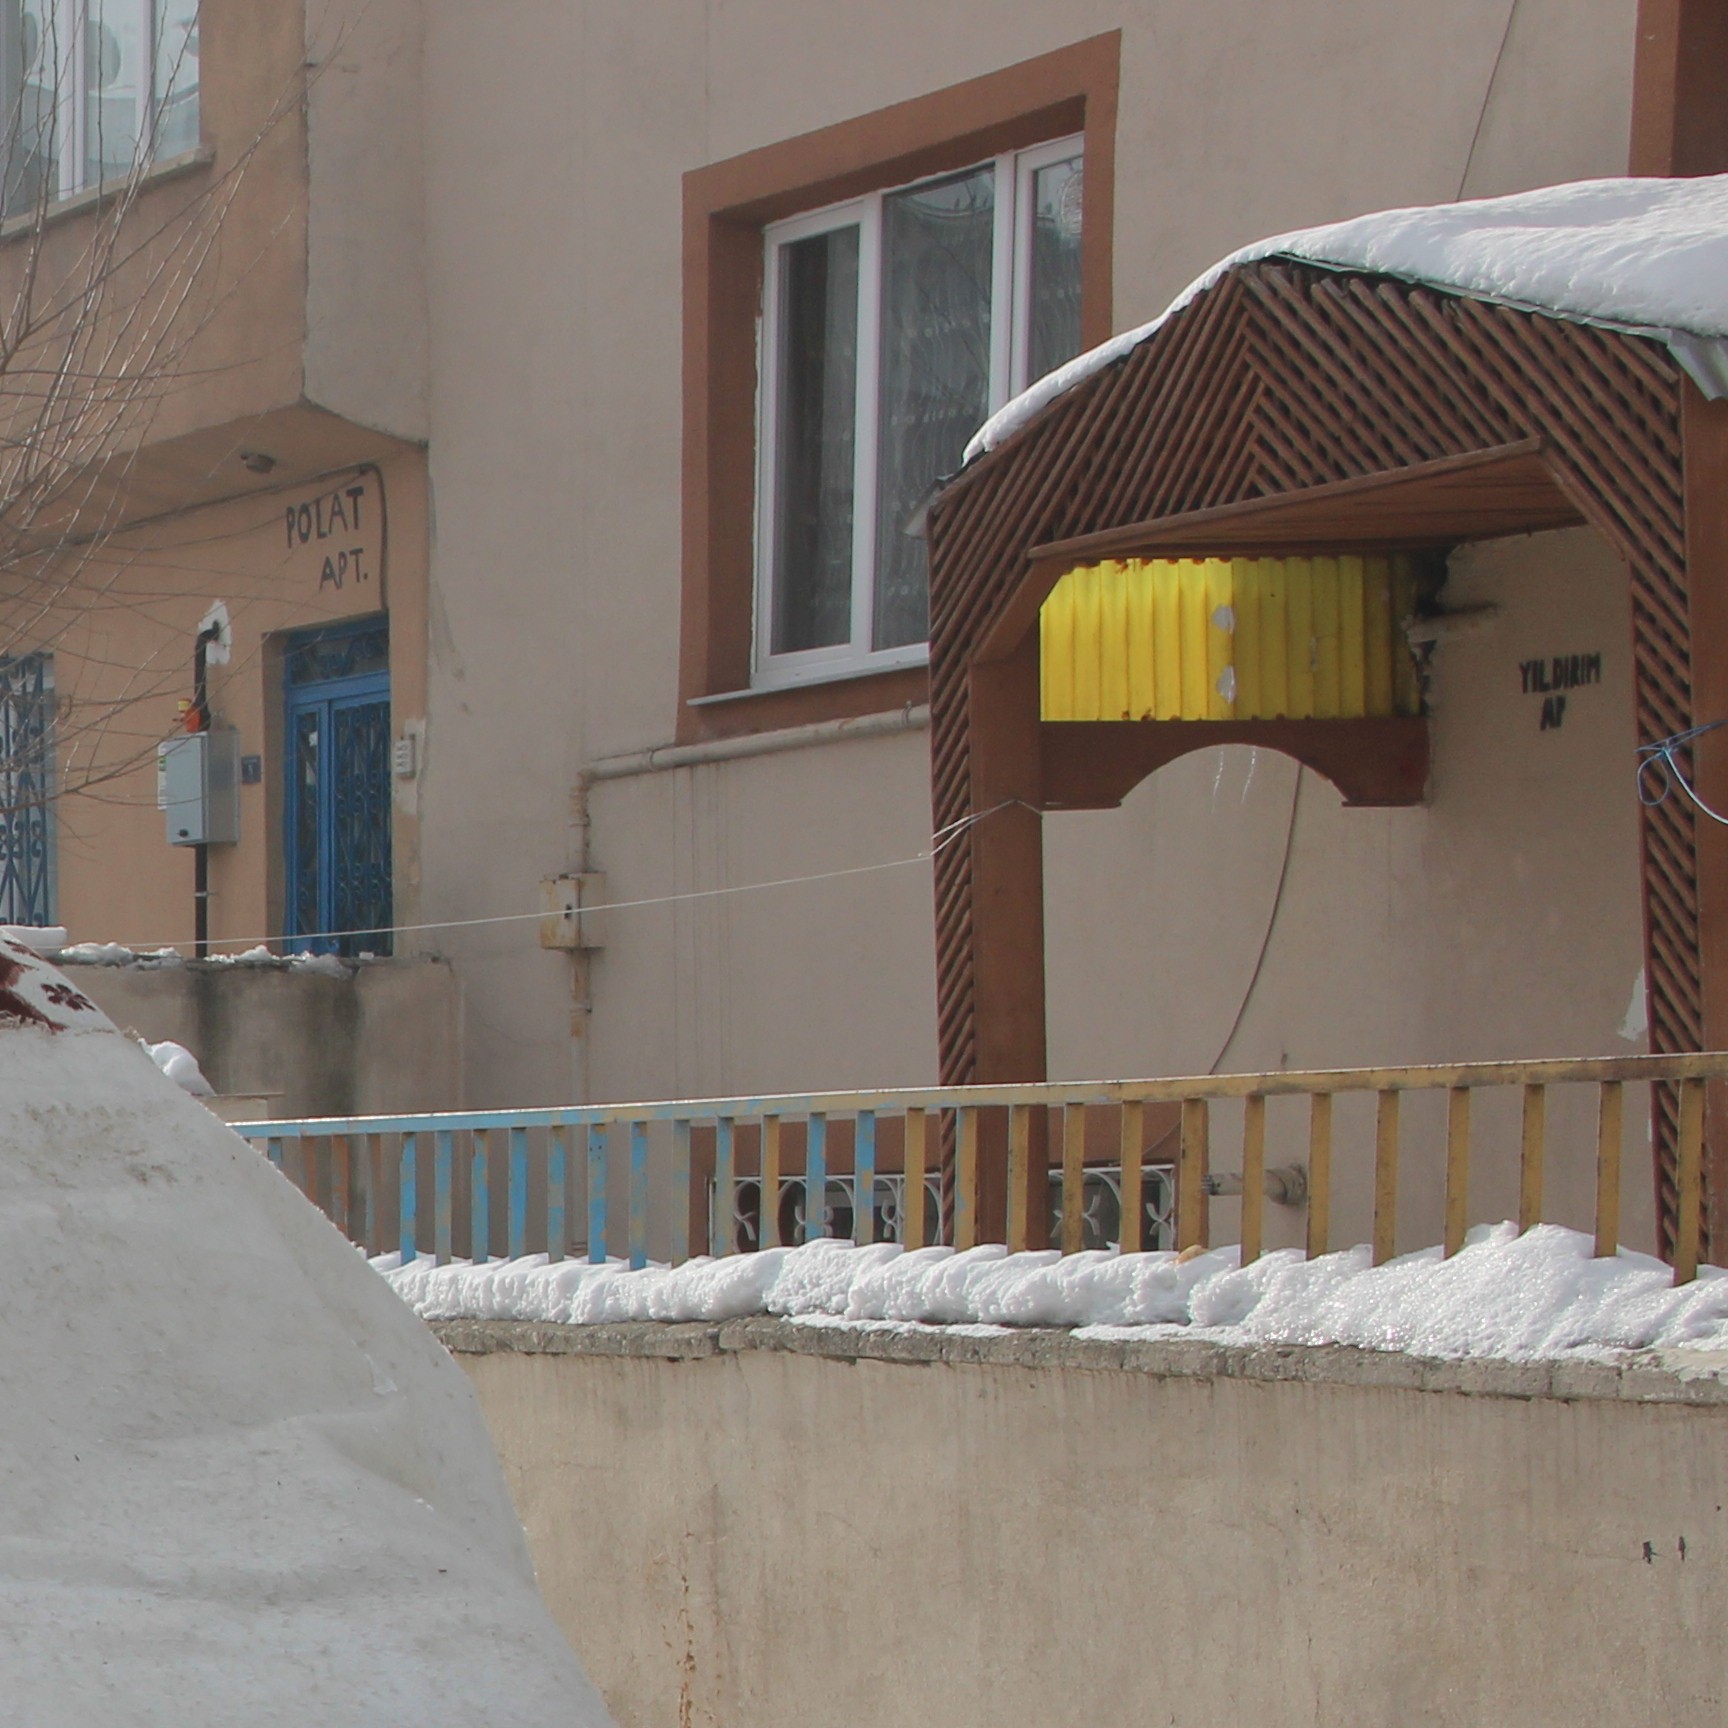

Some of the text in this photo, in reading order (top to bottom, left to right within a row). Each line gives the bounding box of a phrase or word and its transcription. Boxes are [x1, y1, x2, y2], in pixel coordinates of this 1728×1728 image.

[286, 486, 364, 549] POLAT
[320, 548, 369, 593] APT.
[1519, 652, 1602, 694] YILDIRIM
